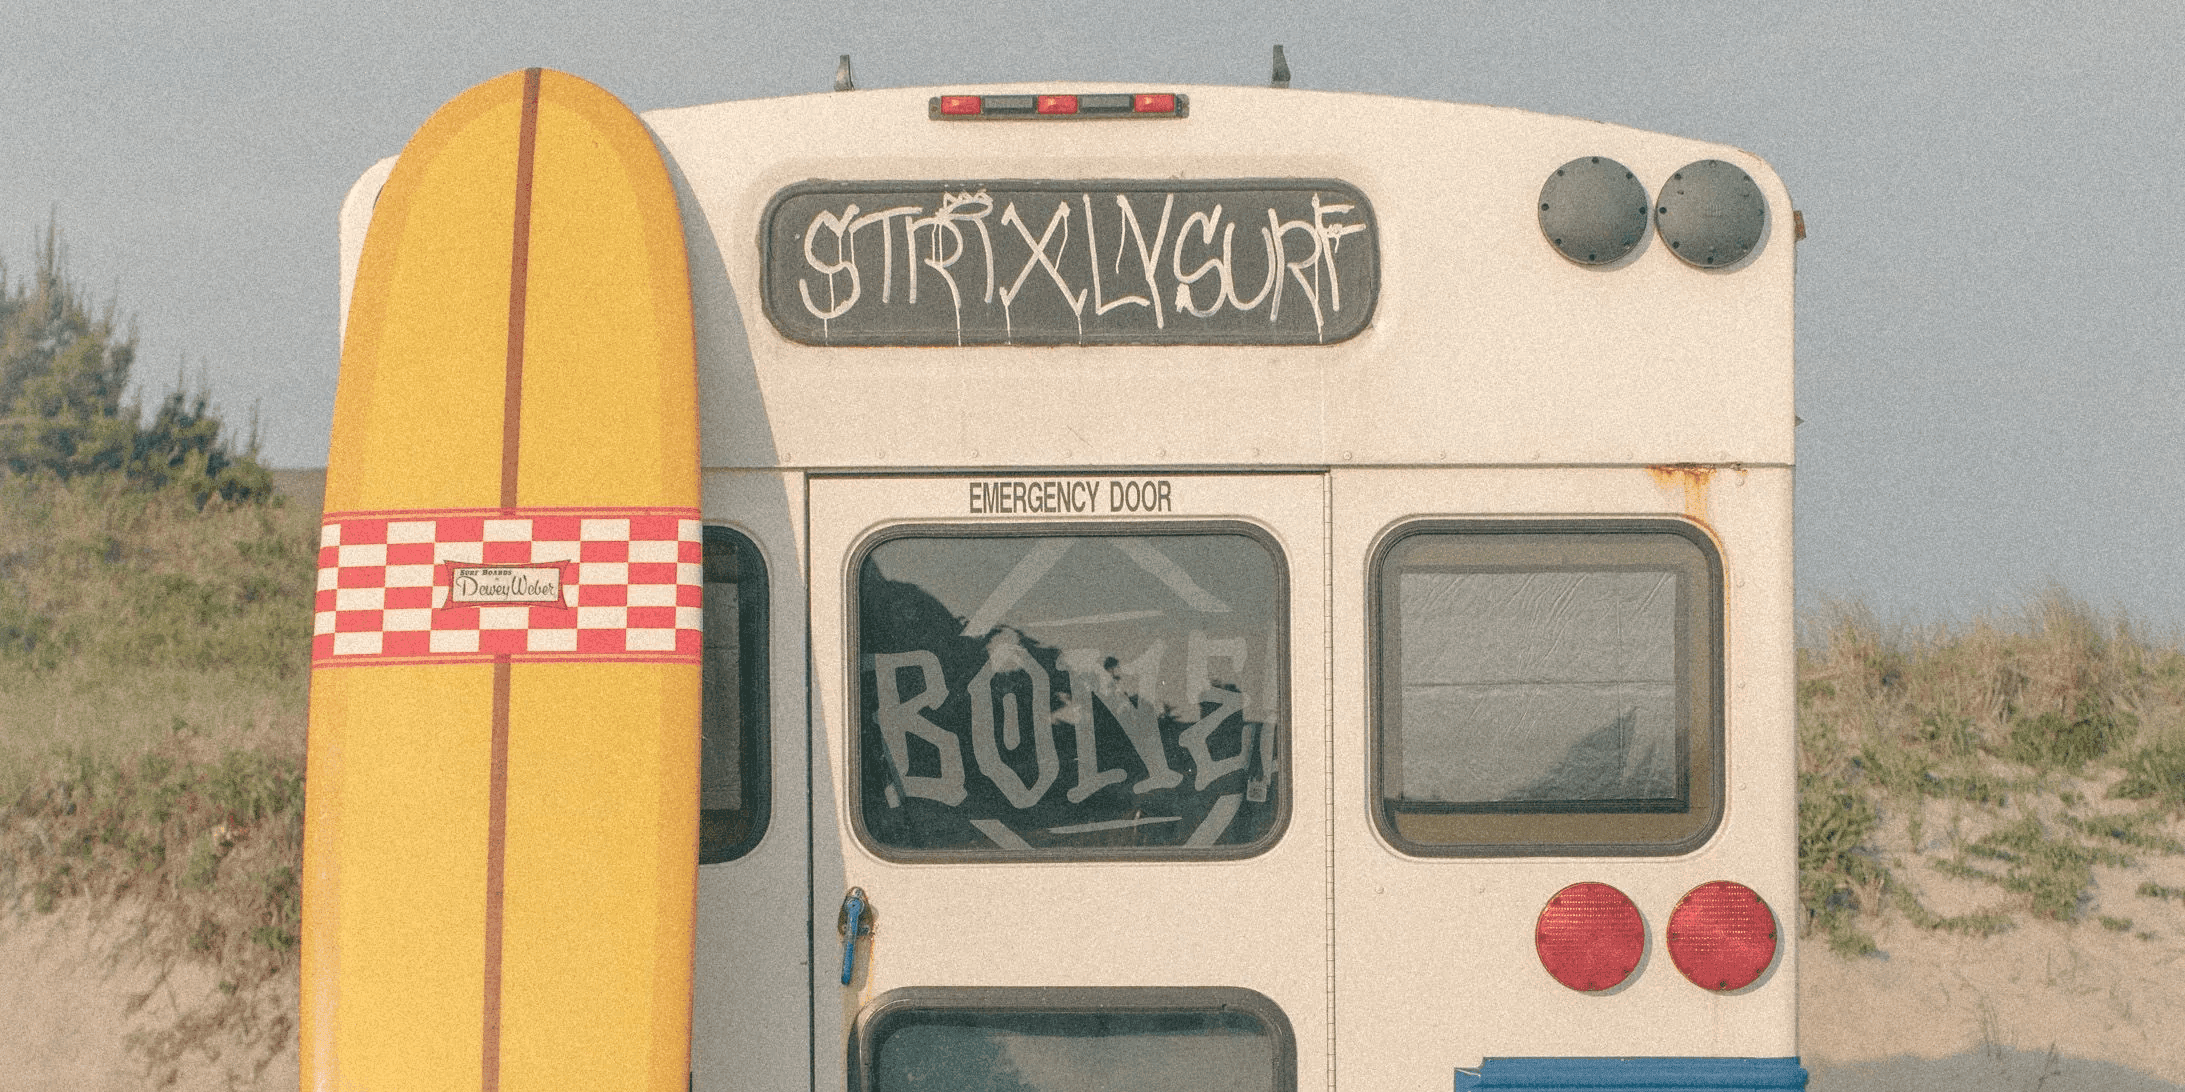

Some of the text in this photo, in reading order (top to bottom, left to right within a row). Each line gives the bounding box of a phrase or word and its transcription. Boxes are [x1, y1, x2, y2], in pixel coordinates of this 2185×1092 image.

[969, 480, 1172, 514] EMERGENCY DOOR
[455, 574, 554, 599] Dewey Weber
